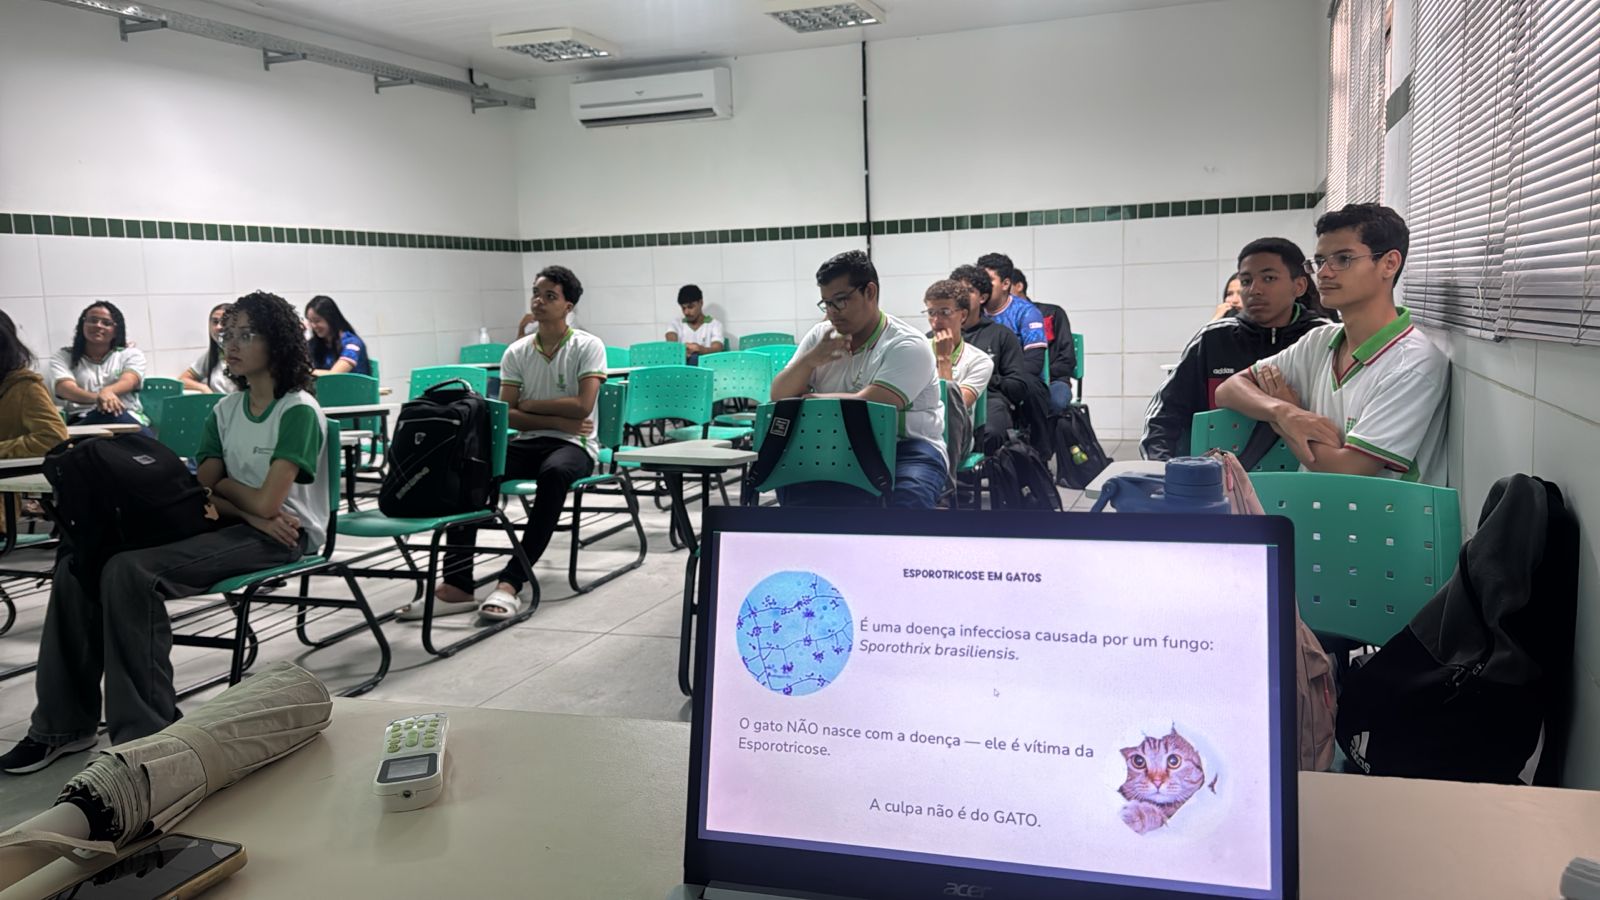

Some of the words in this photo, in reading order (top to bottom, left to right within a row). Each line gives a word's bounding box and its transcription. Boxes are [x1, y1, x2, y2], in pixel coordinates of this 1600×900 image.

[902, 568, 985, 581] ESPOROTRICOSE
[987, 571, 1003, 581] EM
[1005, 572, 1042, 583] GATOS
[859, 616, 869, 632] É
[872, 622, 901, 633] uma
[905, 621, 956, 639] doença
[959, 624, 1031, 641] infecciosa
[1034, 630, 1098, 644] causada
[1102, 635, 1129, 648] por
[1132, 636, 1158, 648] um
[1162, 635, 1214, 653] fungo:
[859, 639, 931, 655] Sporothrix
[934, 643, 1020, 661] brasiliensis.
[738, 736, 831, 756] Esporotricose.
[739, 717, 750, 730] O
[753, 719, 783, 733] gato
[787, 718, 819, 735] NÃO
[822, 725, 861, 738] nasce
[864, 729, 893, 741] com
[897, 731, 906, 742] a
[909, 731, 961, 749] doença
[984, 737, 1007, 751] ele
[1010, 738, 1021, 752] é
[1023, 739, 1071, 756] vítima
[1074, 744, 1094, 758] da
[869, 798, 881, 811] A
[884, 801, 923, 817] culpa
[926, 803, 954, 819] não
[957, 806, 967, 820] é
[970, 808, 990, 822] do
[993, 810, 1041, 828] GATO.
[943, 882, 993, 898] acer
